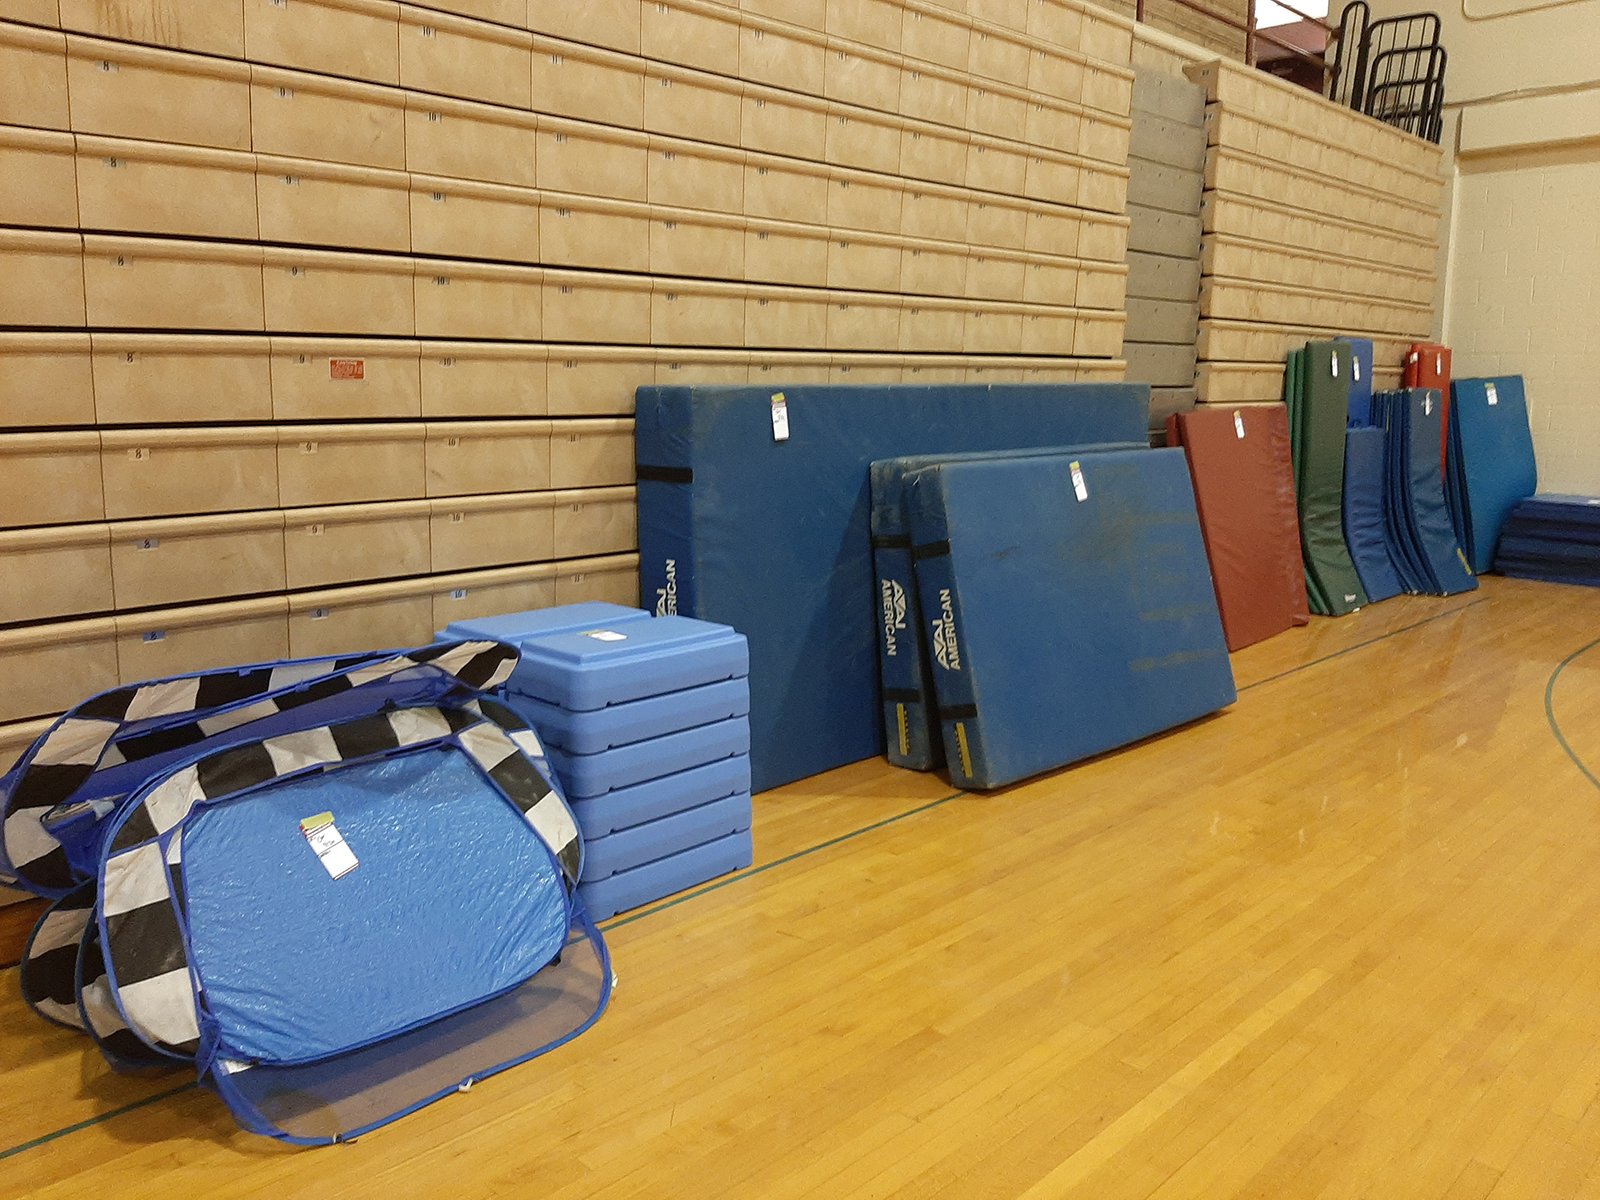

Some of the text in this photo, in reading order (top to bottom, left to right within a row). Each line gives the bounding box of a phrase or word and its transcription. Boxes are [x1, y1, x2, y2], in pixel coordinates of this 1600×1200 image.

[666, 559, 677, 616] ERICAN
[881, 579, 896, 656] AMERICAN
[940, 589, 960, 669] AMERICAN
